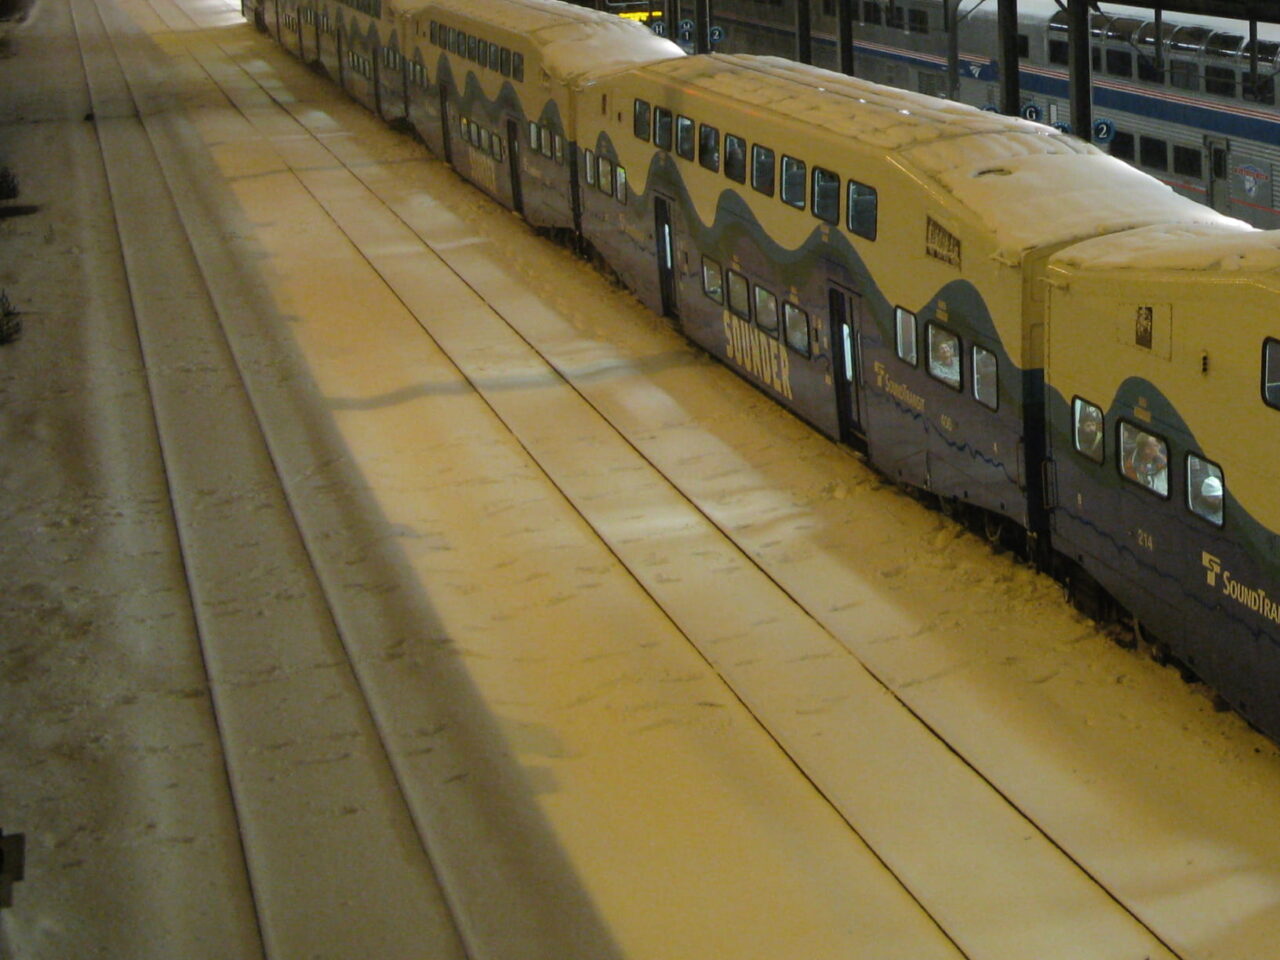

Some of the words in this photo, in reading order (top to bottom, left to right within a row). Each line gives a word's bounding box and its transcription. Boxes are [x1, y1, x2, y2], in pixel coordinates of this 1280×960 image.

[713, 31, 720, 40] 2
[1026, 107, 1036, 120] G
[1098, 124, 1108, 138] 2
[723, 309, 793, 400] SOUNDER
